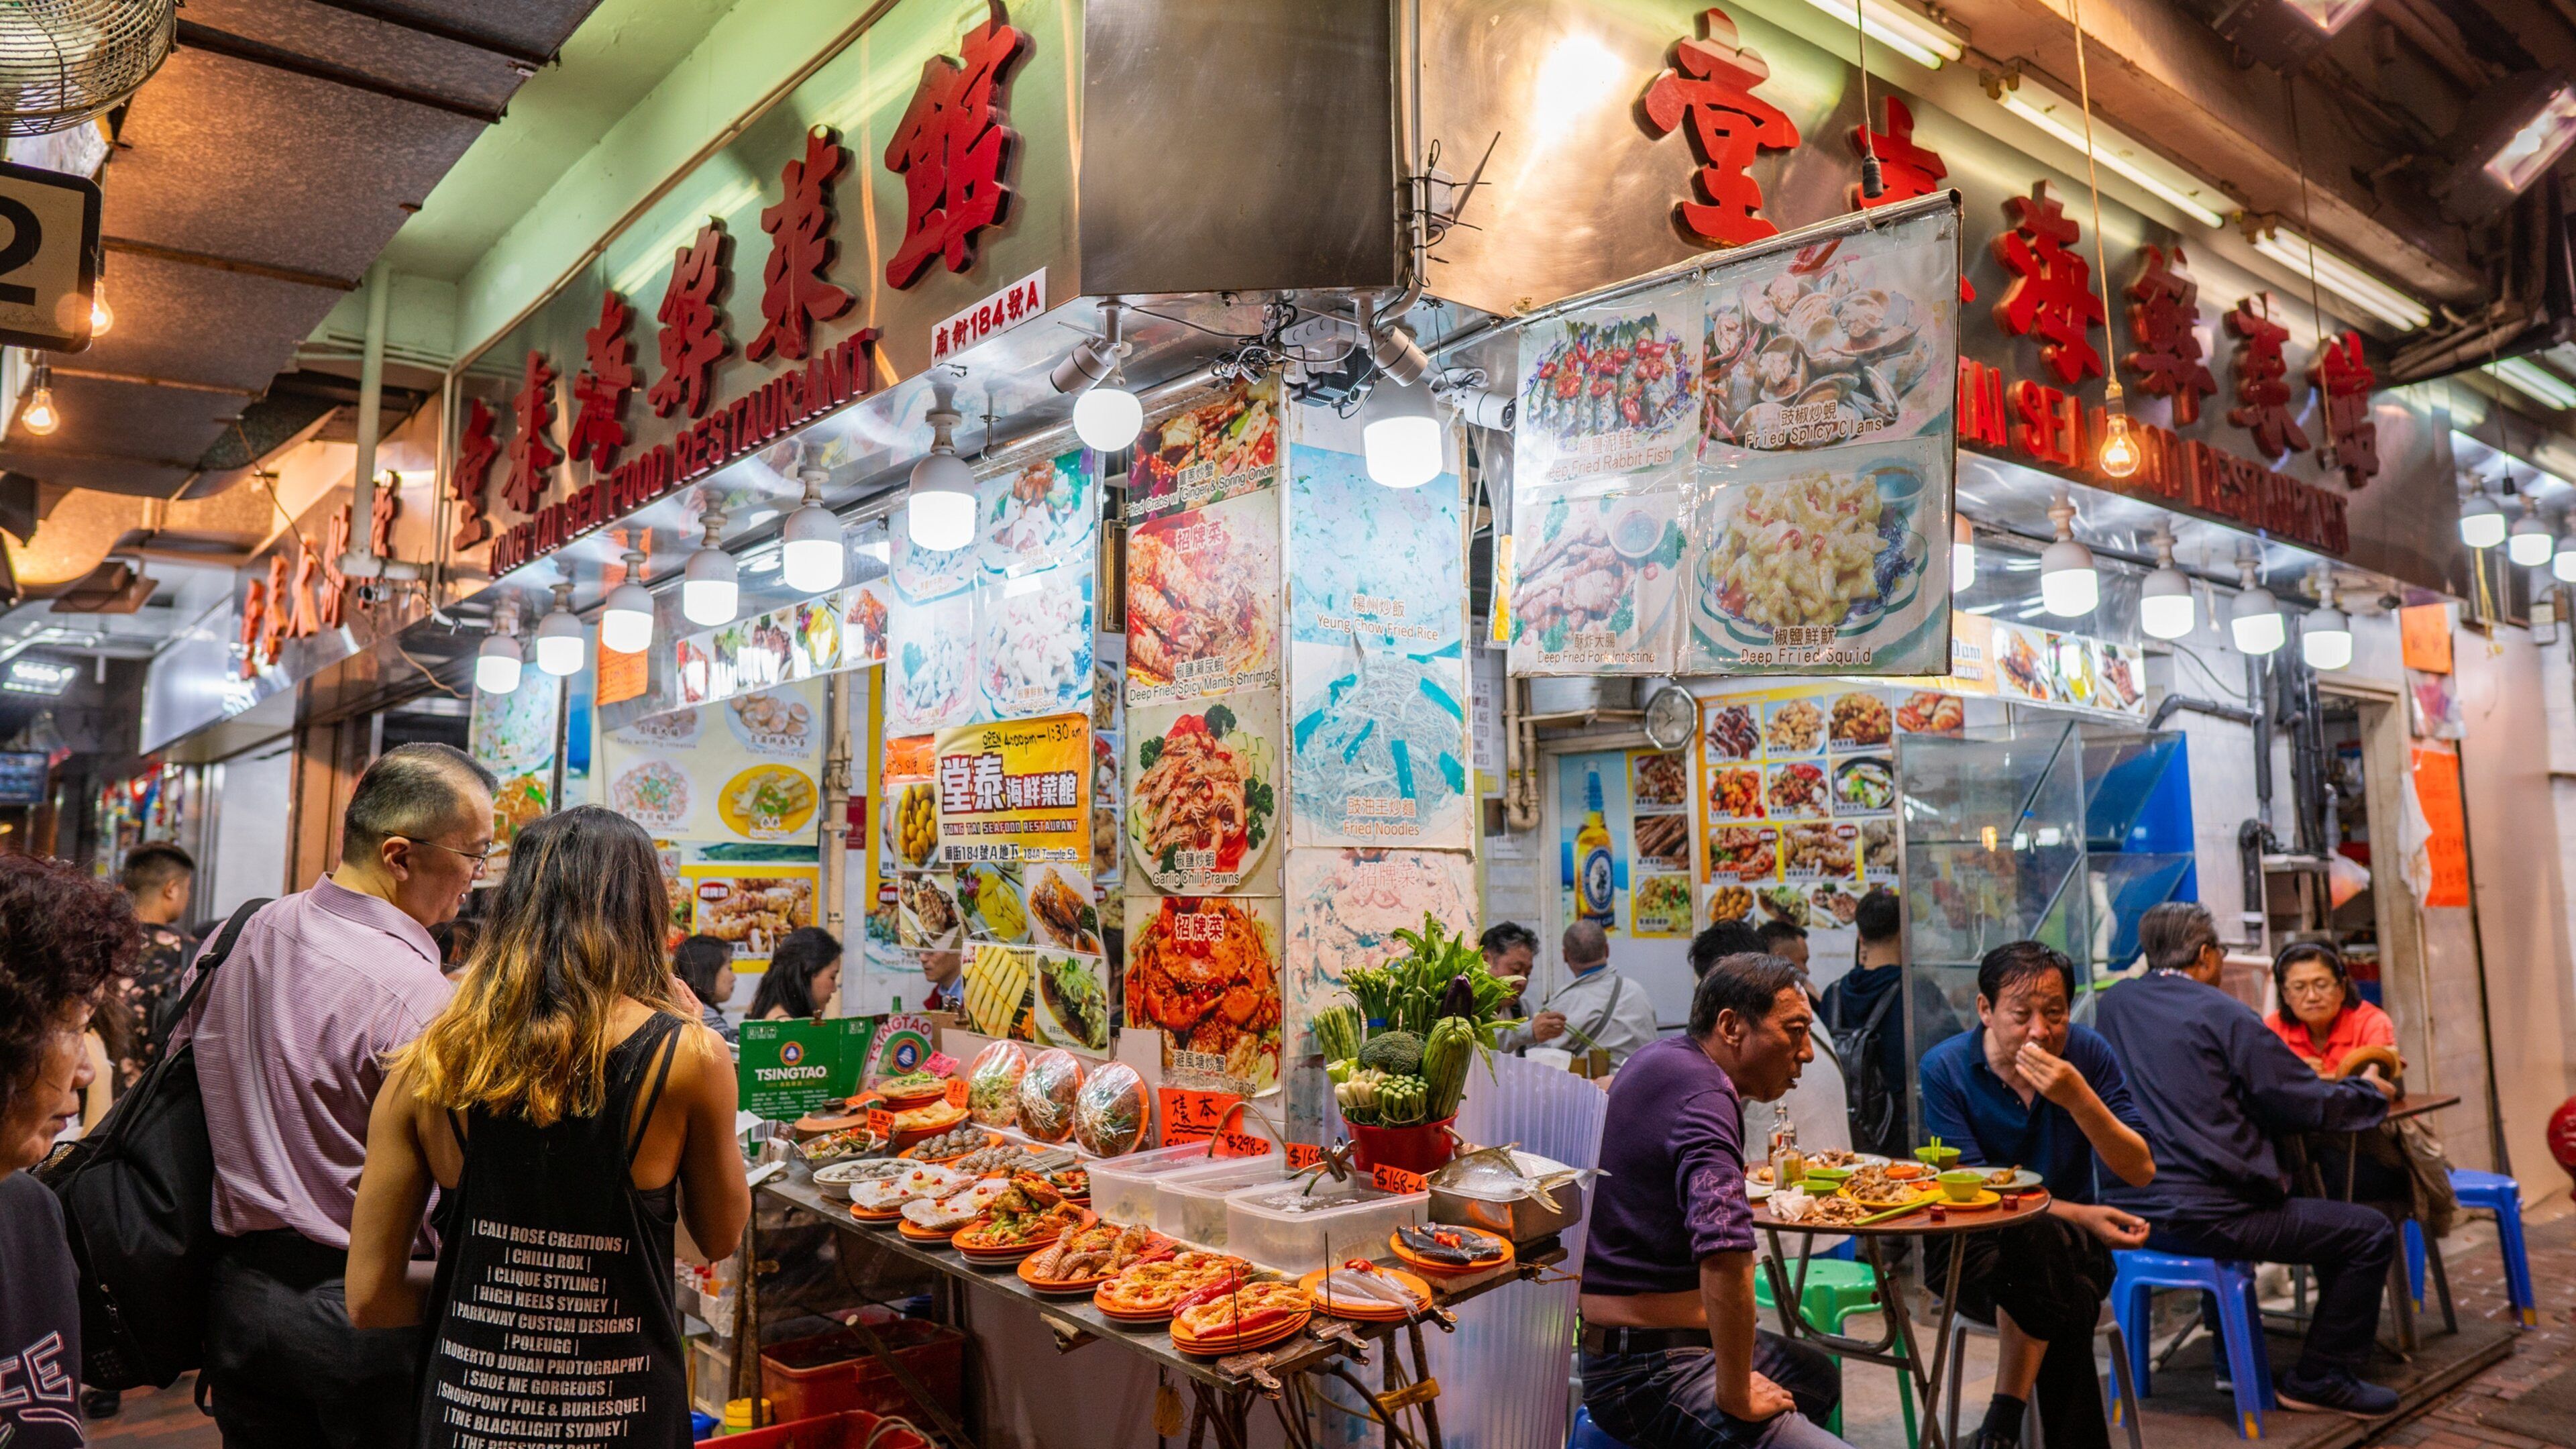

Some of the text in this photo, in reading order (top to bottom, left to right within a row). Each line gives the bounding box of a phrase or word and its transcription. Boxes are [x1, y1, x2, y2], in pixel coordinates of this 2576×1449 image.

[534, 502, 567, 556] TAI
[607, 443, 672, 519] FOOD
[673, 327, 877, 485] RESTAURANT
[1746, 429, 1785, 447] Fried
[1839, 419, 1882, 435] Clams
[1572, 459, 1600, 474] Fried
[1603, 452, 1642, 470] Rabbit
[1646, 446, 1672, 464] Fish
[1146, 493, 1169, 511] Crabs
[1181, 483, 1208, 501] Ginger
[1210, 481, 1216, 492] &
[1218, 474, 1246, 490] Spring
[1248, 464, 1275, 481] Onion
[1177, 520, 1222, 552] 招牌菜
[1316, 613, 1438, 641] Yeung Chow Fried Rice
[1574, 633, 1616, 649] 酥炸大腸
[1538, 650, 1560, 664] Deep
[1563, 650, 1585, 663] Fried
[1611, 650, 1656, 663] Intestine
[1741, 647, 1871, 666] Deep Fried Squid
[1130, 669, 1277, 702] Deep Fried Spicy Mantis Shrimps
[983, 731, 1002, 747] OPEN
[941, 752, 1079, 814] 堂泰海鮮菜館
[943, 818, 1078, 836] TONG TAI SEAFOOD RESTAURANT
[1343, 820, 1420, 836] Fried Noodles
[1024, 848, 1078, 862] 184A Temple St.
[1152, 871, 1240, 885] Garlic Chili Prawns
[1360, 863, 1415, 888] 招牌菜
[1177, 914, 1223, 940] 招牌菜
[868, 1015, 931, 1063] TSINGTAO
[755, 1065, 827, 1081] TSINGTAO
[478, 1219, 623, 1252] CALI ROSE CREATIONS
[512, 1248, 584, 1271] CHILLI ROX
[494, 1267, 599, 1293] CLIQUE STYLING
[480, 1285, 609, 1313] HIGH HEELS SYDNEY
[457, 1301, 635, 1334] PARKWAY CUSTOM DESIGNS
[511, 1334, 572, 1354] POLEUGG
[445, 1340, 645, 1375] ROBERTO DURAN PHOTOGRAPHY
[470, 1370, 606, 1396] SHOE ME GORGEOUS
[441, 1381, 639, 1417] SHOWPONY POLE & BURLESQUE
[450, 1407, 621, 1439] THE BLACKLIGHT SYDNEY
[462, 1433, 485, 1449] THE
